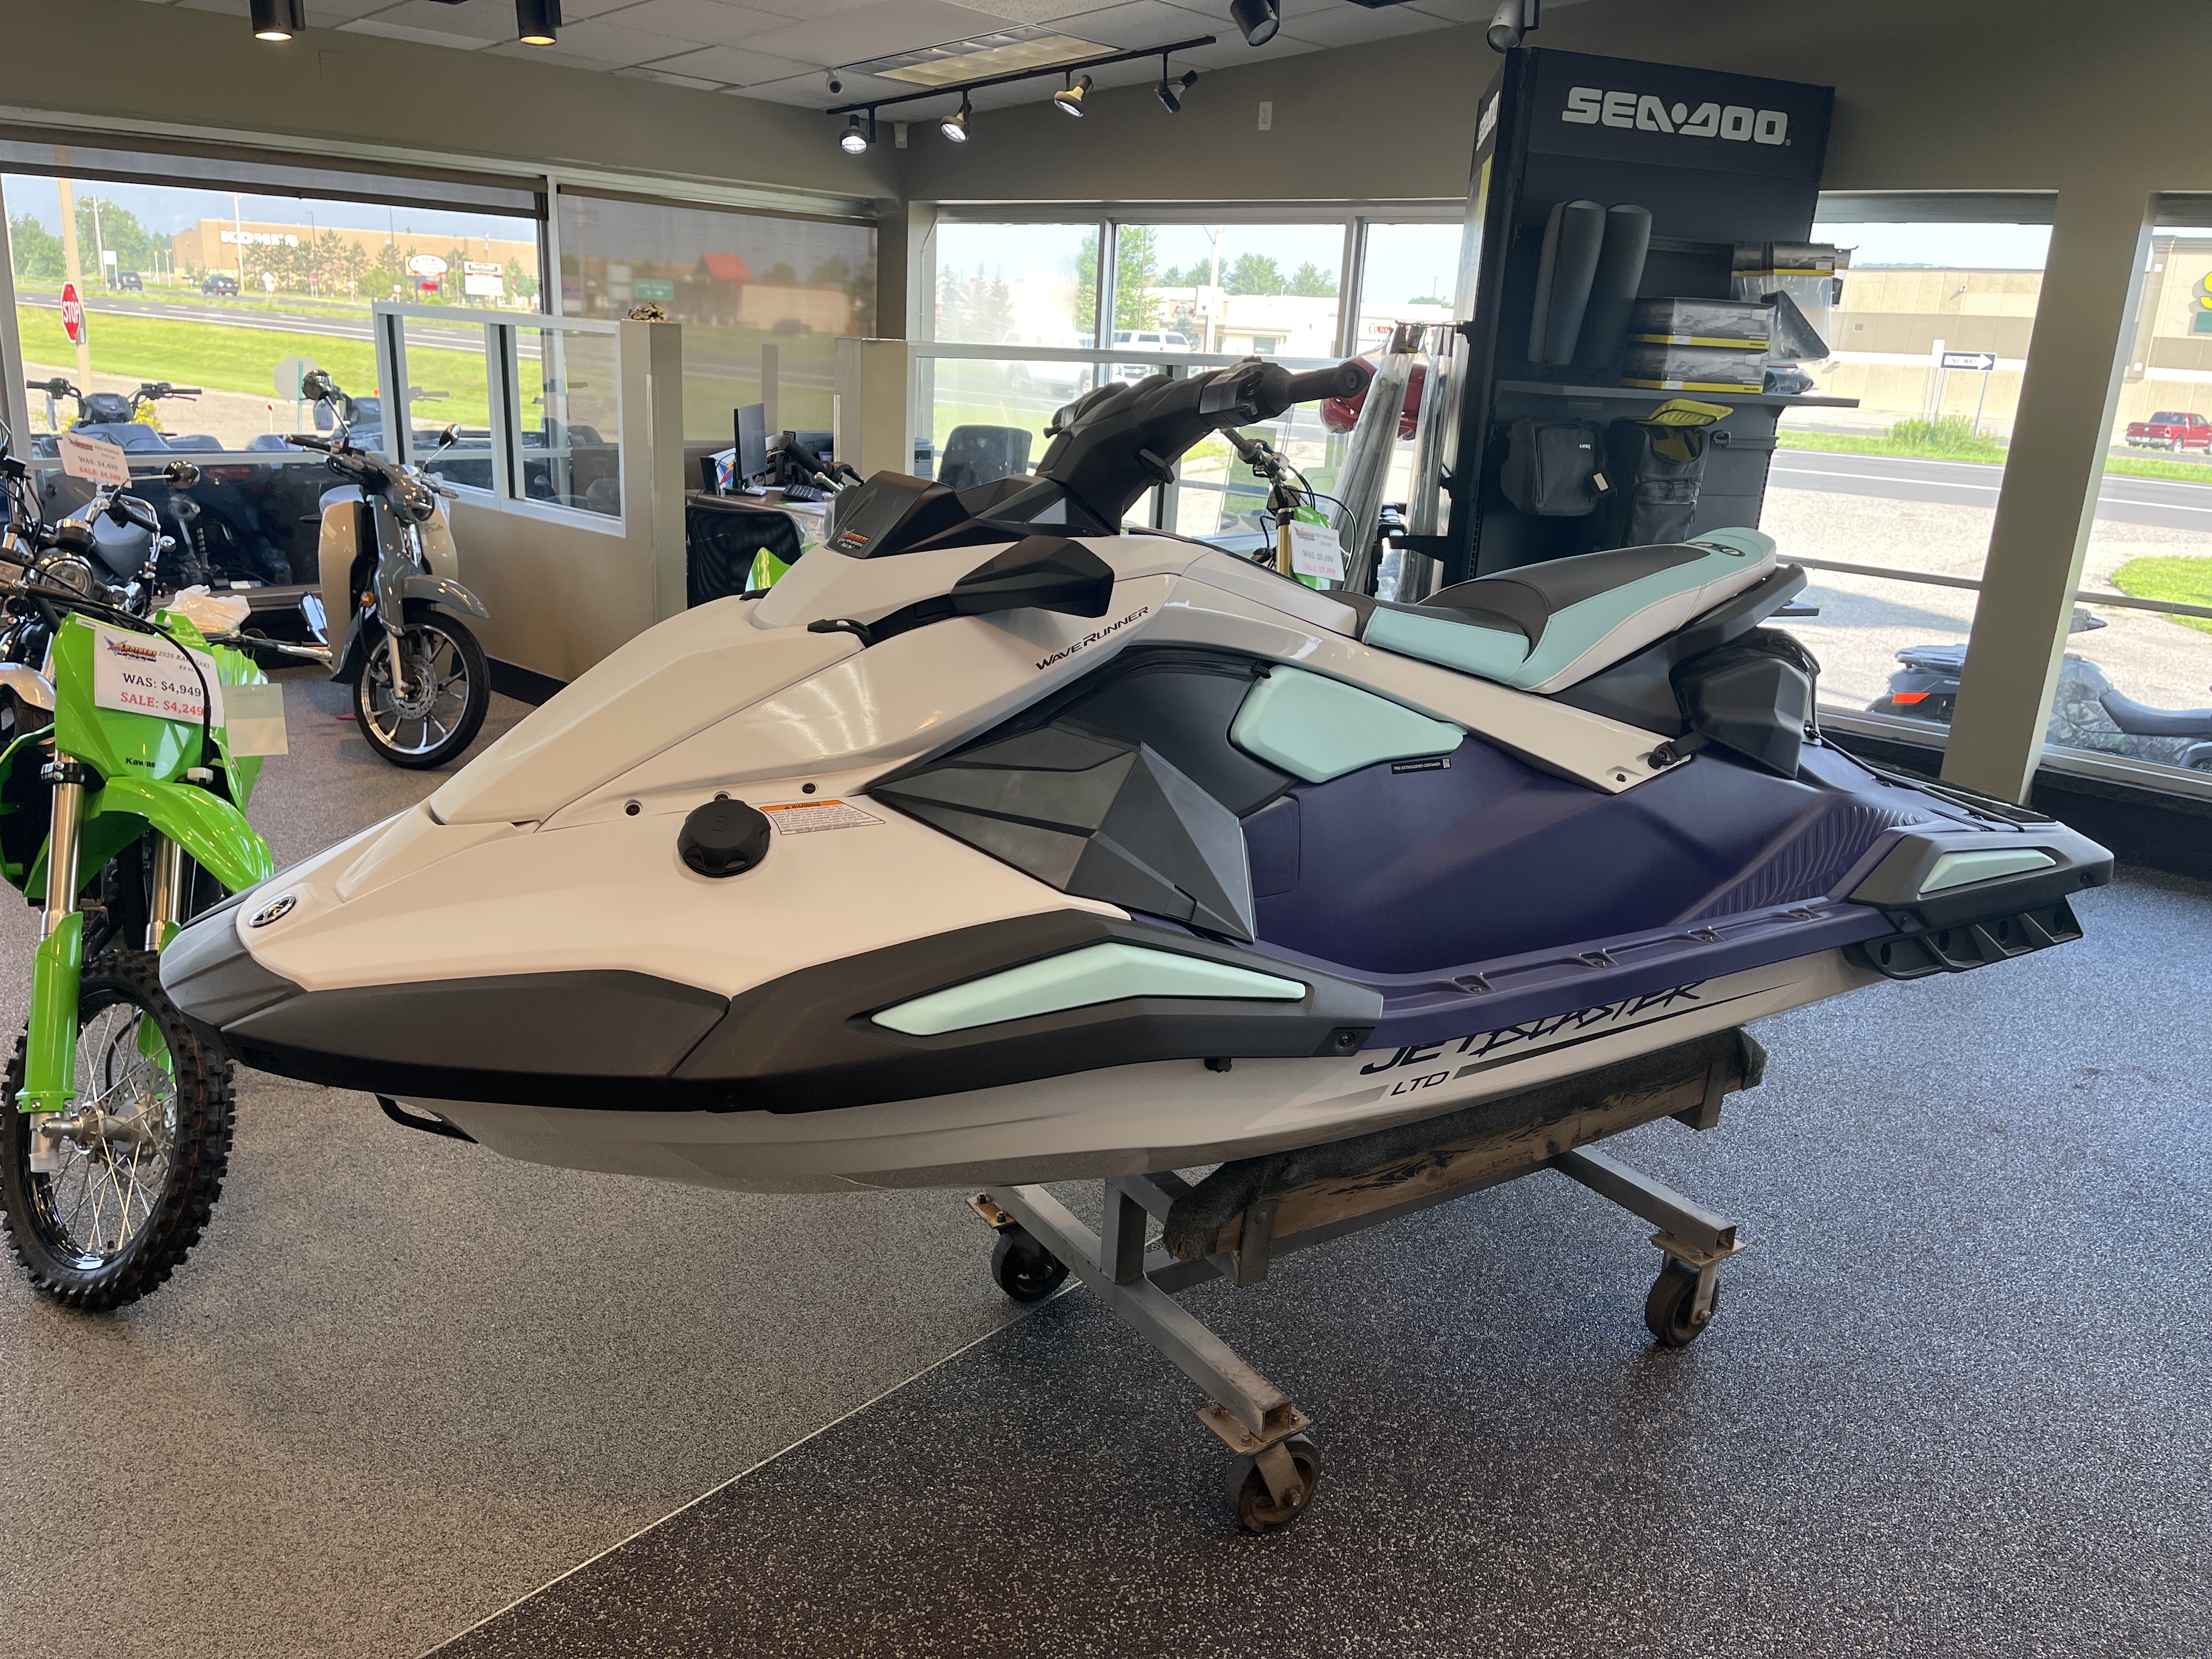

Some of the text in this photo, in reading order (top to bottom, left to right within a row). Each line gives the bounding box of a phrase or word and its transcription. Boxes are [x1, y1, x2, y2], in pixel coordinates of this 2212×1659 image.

[63, 301, 79, 324] STOP
[78, 456, 118, 470] WAS: $4,499
[79, 466, 98, 475] SALE:
[1302, 550, 1333, 562] WAS: $9,099
[1303, 563, 1318, 572] SALE:
[1035, 606, 1149, 670] WAVERUNNER
[122, 673, 201, 697] WAS: $4,949
[120, 692, 205, 716] SALE: $4,249
[1390, 1071, 1450, 1096] LTD
